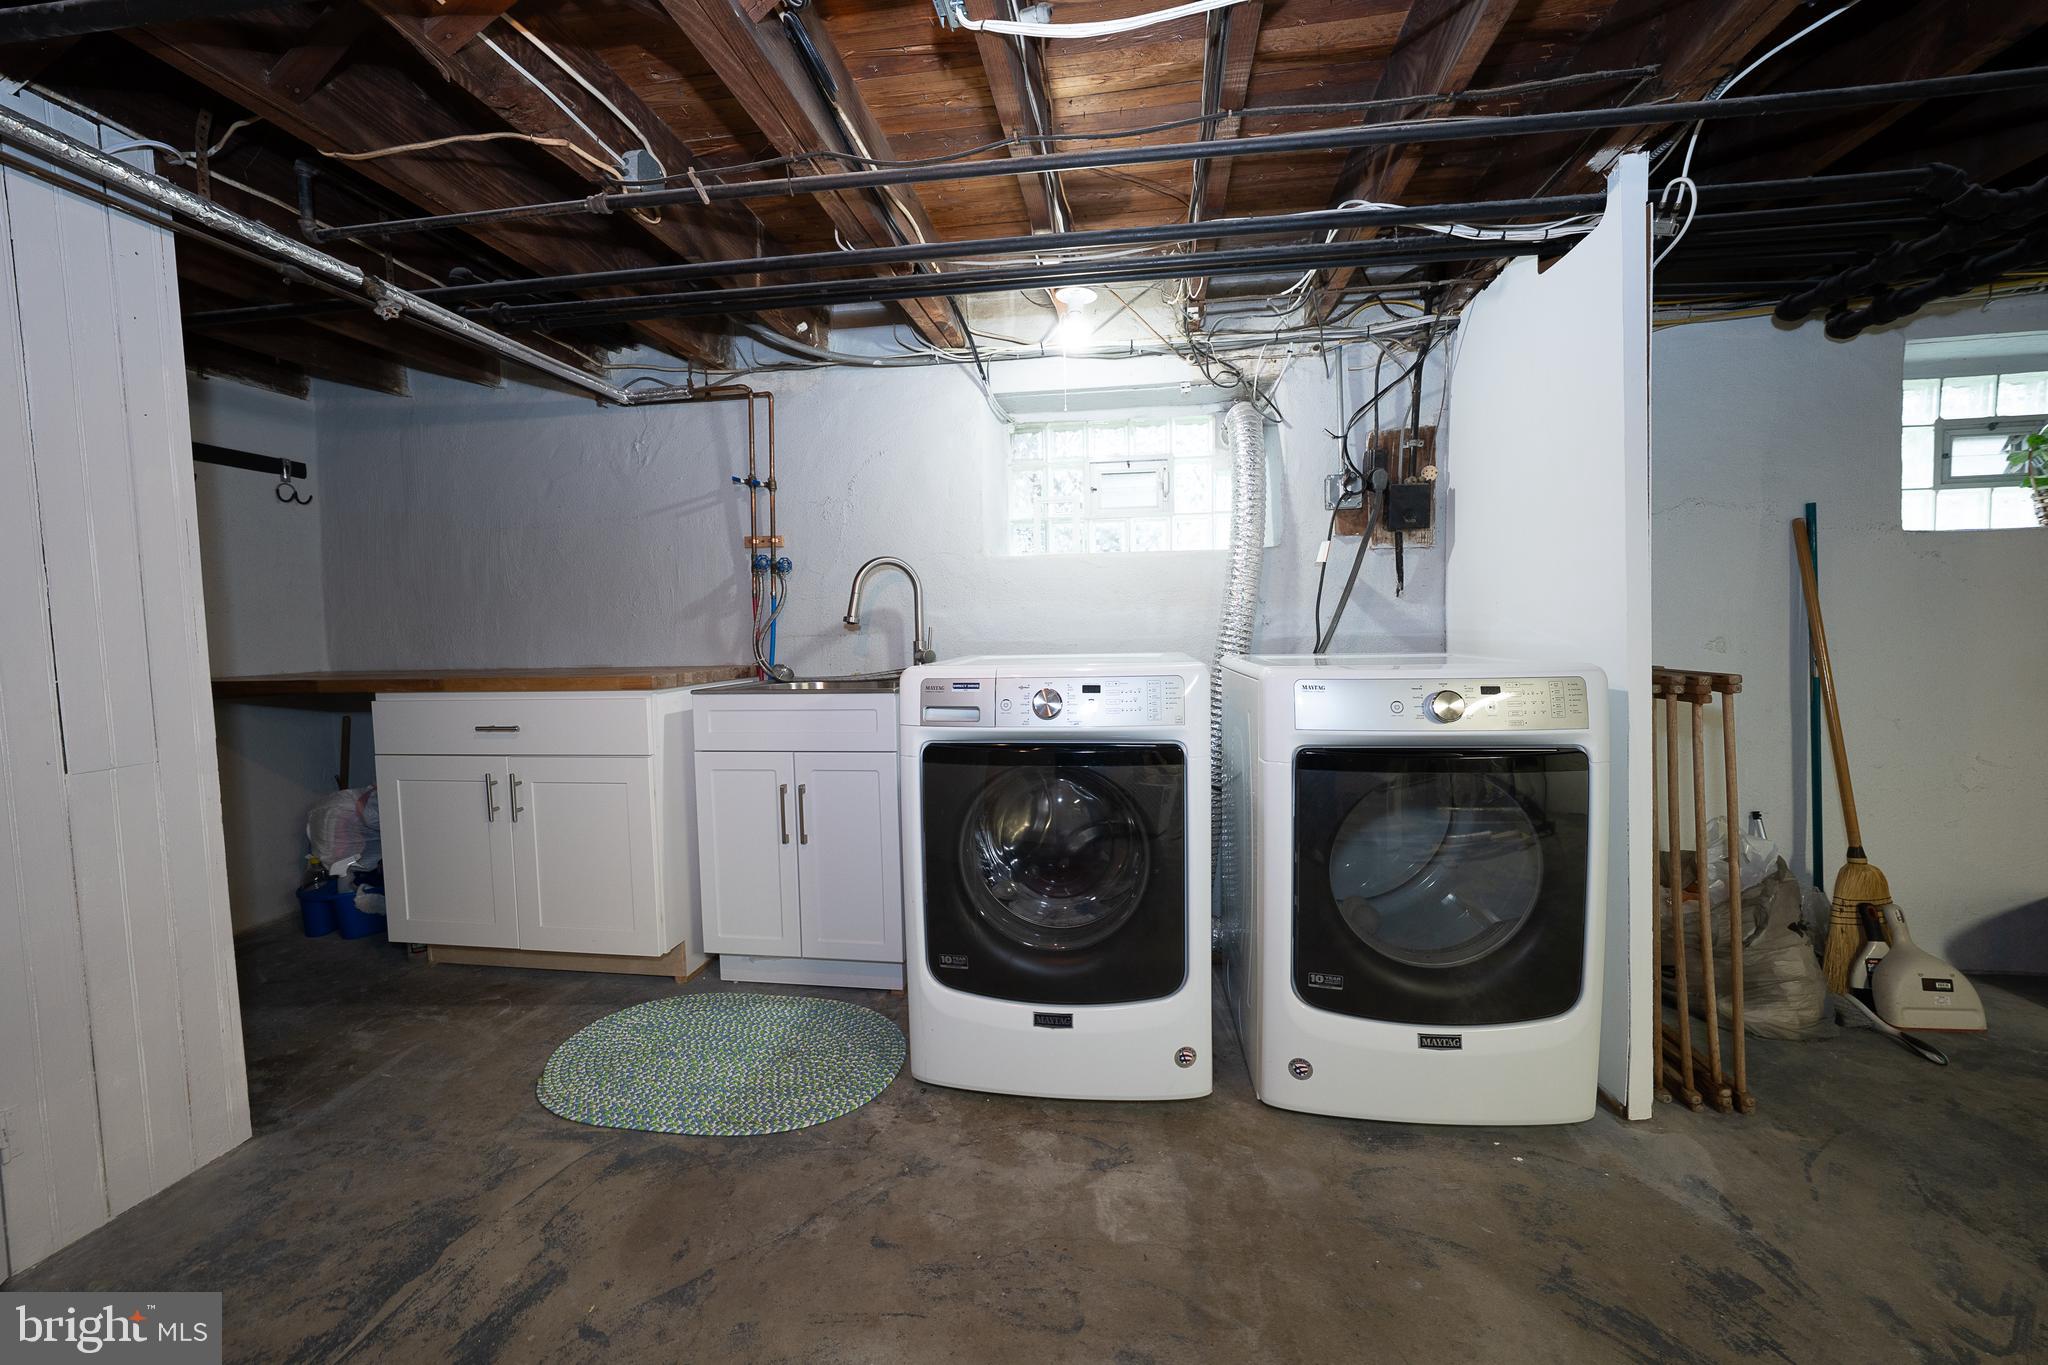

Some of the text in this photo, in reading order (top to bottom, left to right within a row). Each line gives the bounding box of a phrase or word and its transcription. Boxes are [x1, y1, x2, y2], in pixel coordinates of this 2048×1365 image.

[941, 955, 952, 963] 10
[1310, 974, 1324, 983] 10
[1036, 1015, 1072, 1025] MAYTAG
[1421, 1038, 1460, 1047] MAYTAG
